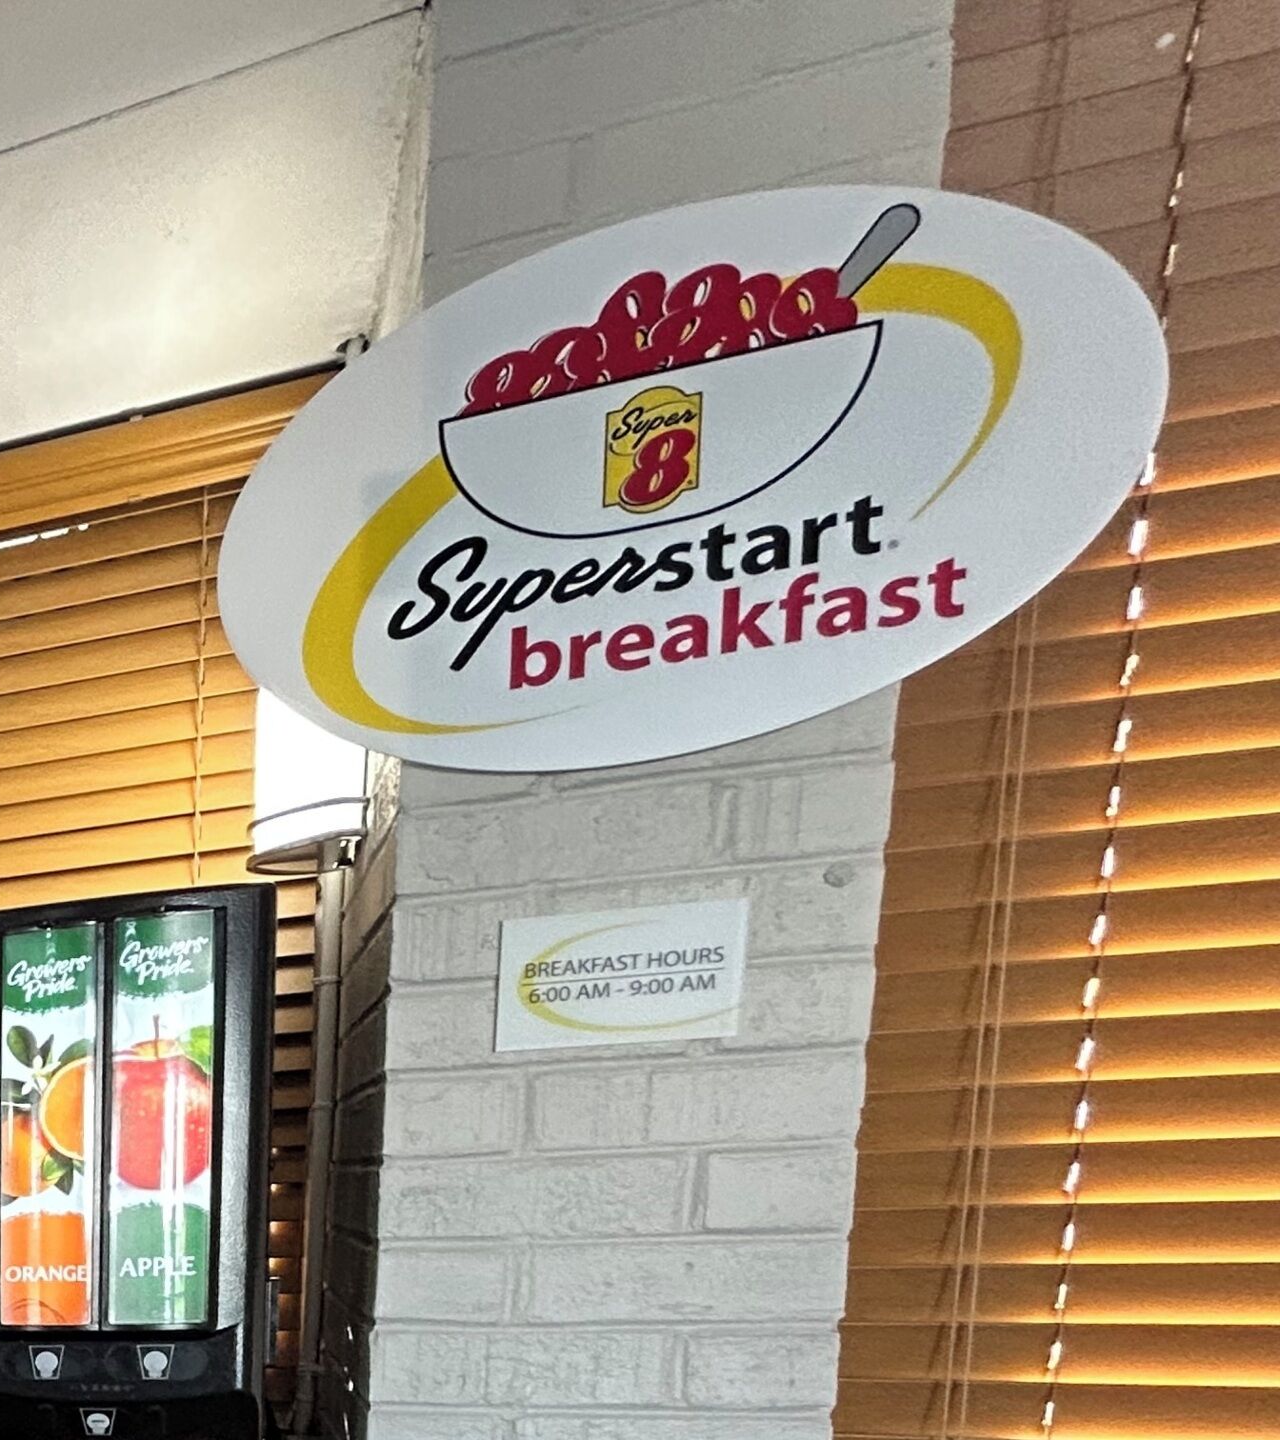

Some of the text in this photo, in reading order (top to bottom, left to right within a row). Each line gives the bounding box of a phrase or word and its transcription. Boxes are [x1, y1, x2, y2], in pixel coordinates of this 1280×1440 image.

[611, 406, 697, 450] Super
[618, 428, 696, 506] 8
[387, 494, 885, 671] Superstart
[508, 557, 968, 690] breakfast
[135, 955, 195, 986] Pride
[524, 946, 725, 979] BREAKFAST HOURS
[22, 973, 78, 1003] Pride
[528, 986, 571, 1004] 6:00
[576, 982, 611, 1000] AM
[629, 977, 674, 997] 9:00
[678, 973, 716, 993] AM
[4, 1264, 89, 1283] ORANGE
[119, 1254, 198, 1278] APPLE
